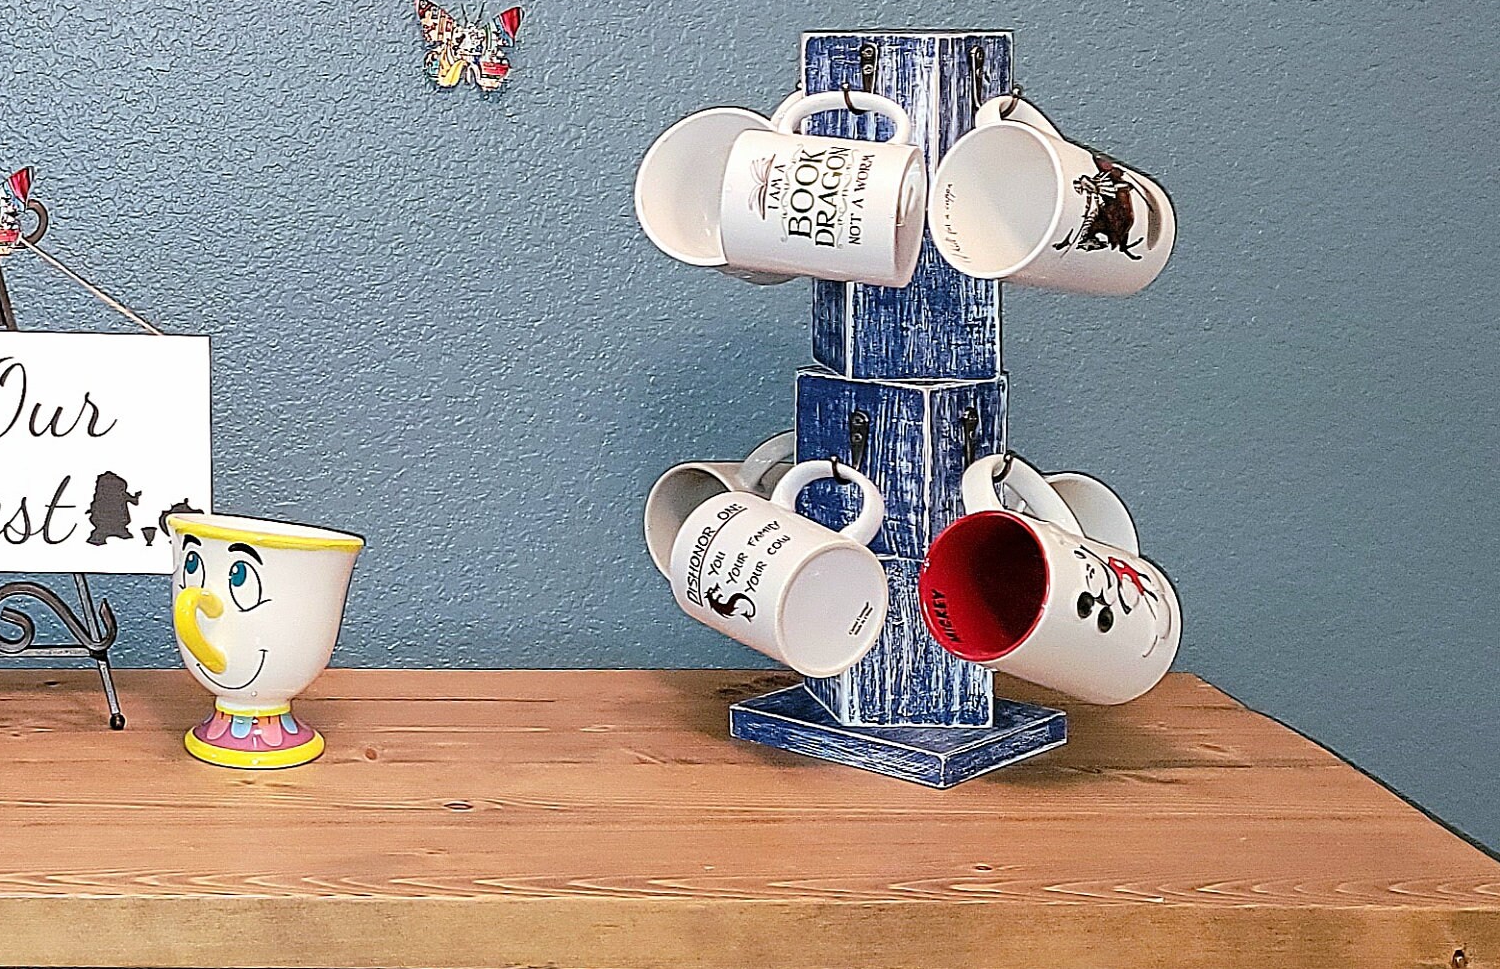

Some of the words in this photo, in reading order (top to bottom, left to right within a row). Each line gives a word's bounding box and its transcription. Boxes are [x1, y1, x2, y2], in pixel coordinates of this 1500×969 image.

[769, 178, 784, 201] AM
[774, 164, 786, 173] A
[854, 154, 876, 192] WORM
[788, 149, 828, 239] BOOK
[815, 146, 851, 248] DRAGON
[851, 198, 865, 209] A
[848, 212, 862, 245] NOT
[687, 526, 716, 607] DISHONOR
[717, 503, 743, 521] ON:
[707, 551, 727, 576] YOU
[726, 552, 749, 585] YOUR
[747, 520, 780, 547] FAMILY
[744, 561, 768, 593] YOUR
[767, 534, 792, 556] COW
[931, 588, 964, 643] MICKEY
